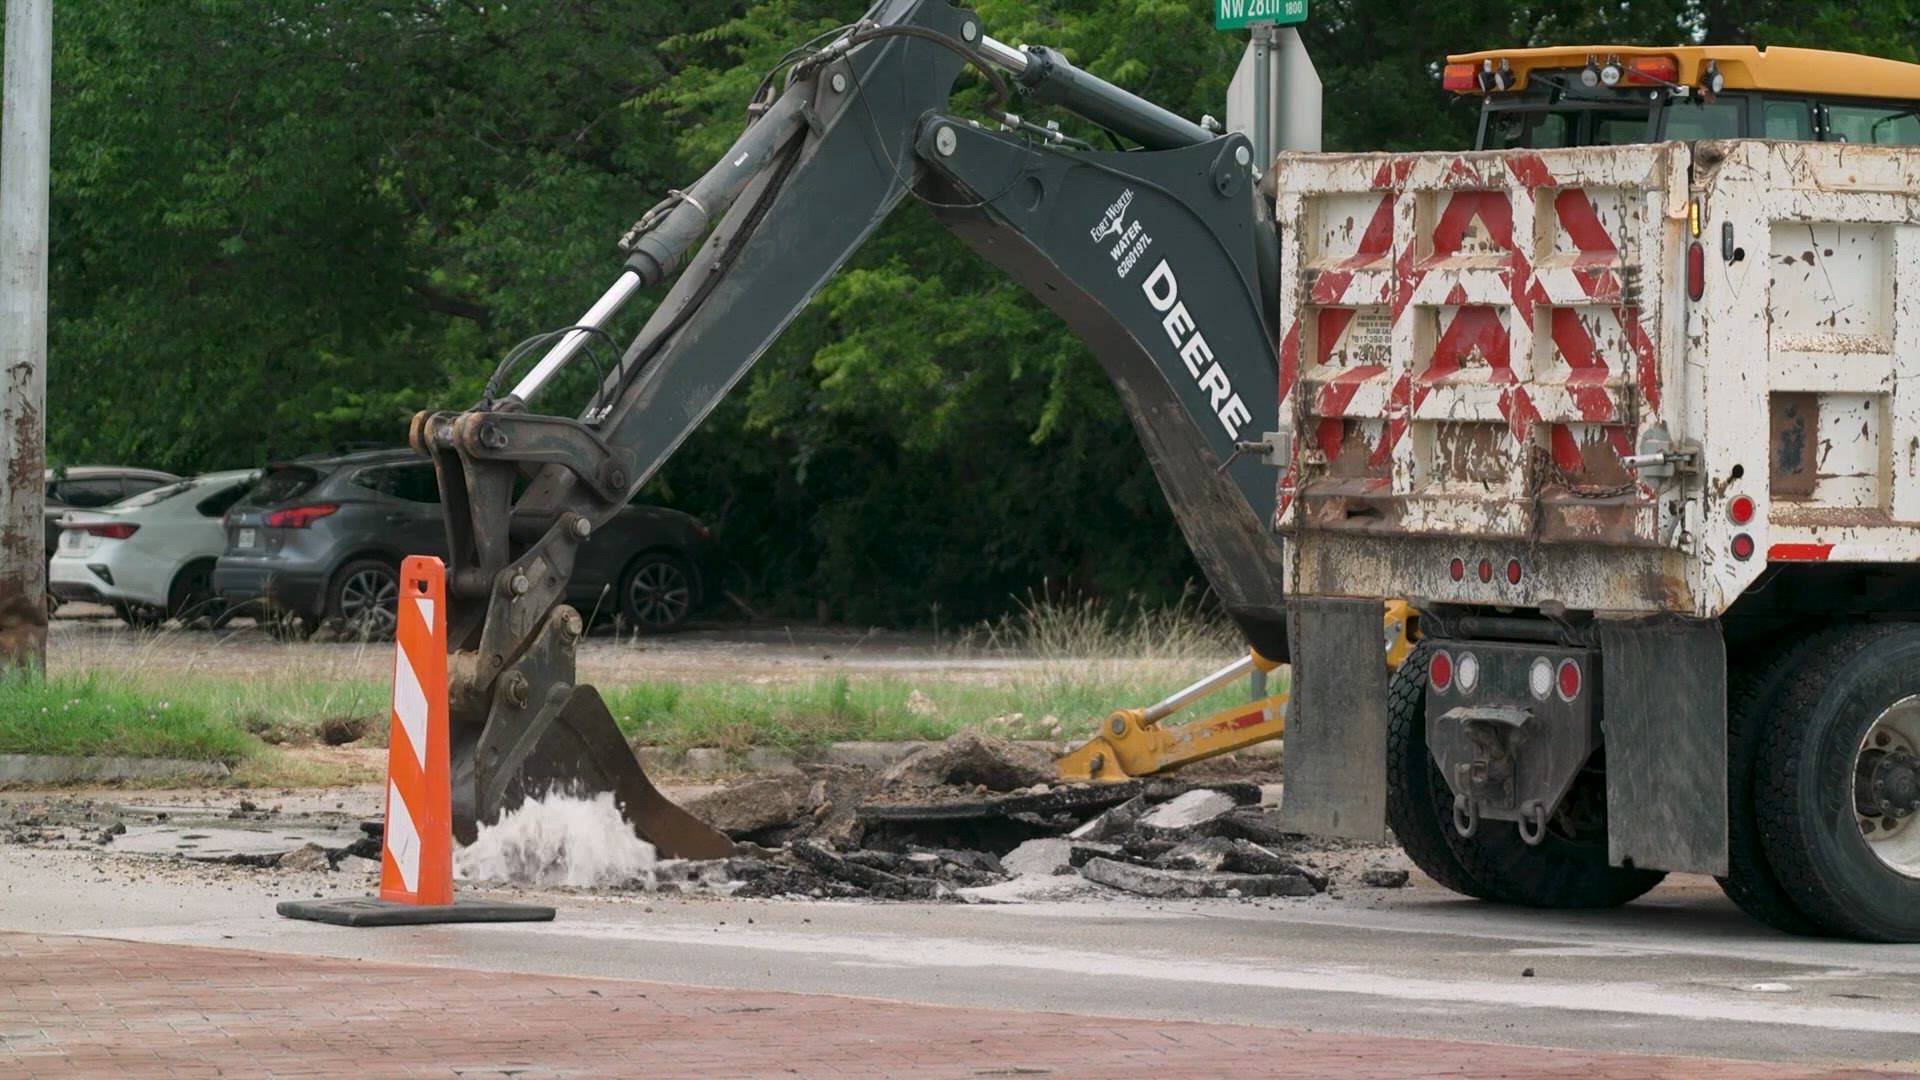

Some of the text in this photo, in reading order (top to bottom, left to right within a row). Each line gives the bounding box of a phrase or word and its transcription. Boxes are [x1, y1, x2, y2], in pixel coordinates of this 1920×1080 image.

[1221, 0, 1244, 19] NW
[1285, 1, 1302, 14] 1800
[1110, 220, 1142, 261] WATER
[1117, 233, 1152, 278] 6260197L
[1141, 258, 1252, 441] DEERE
